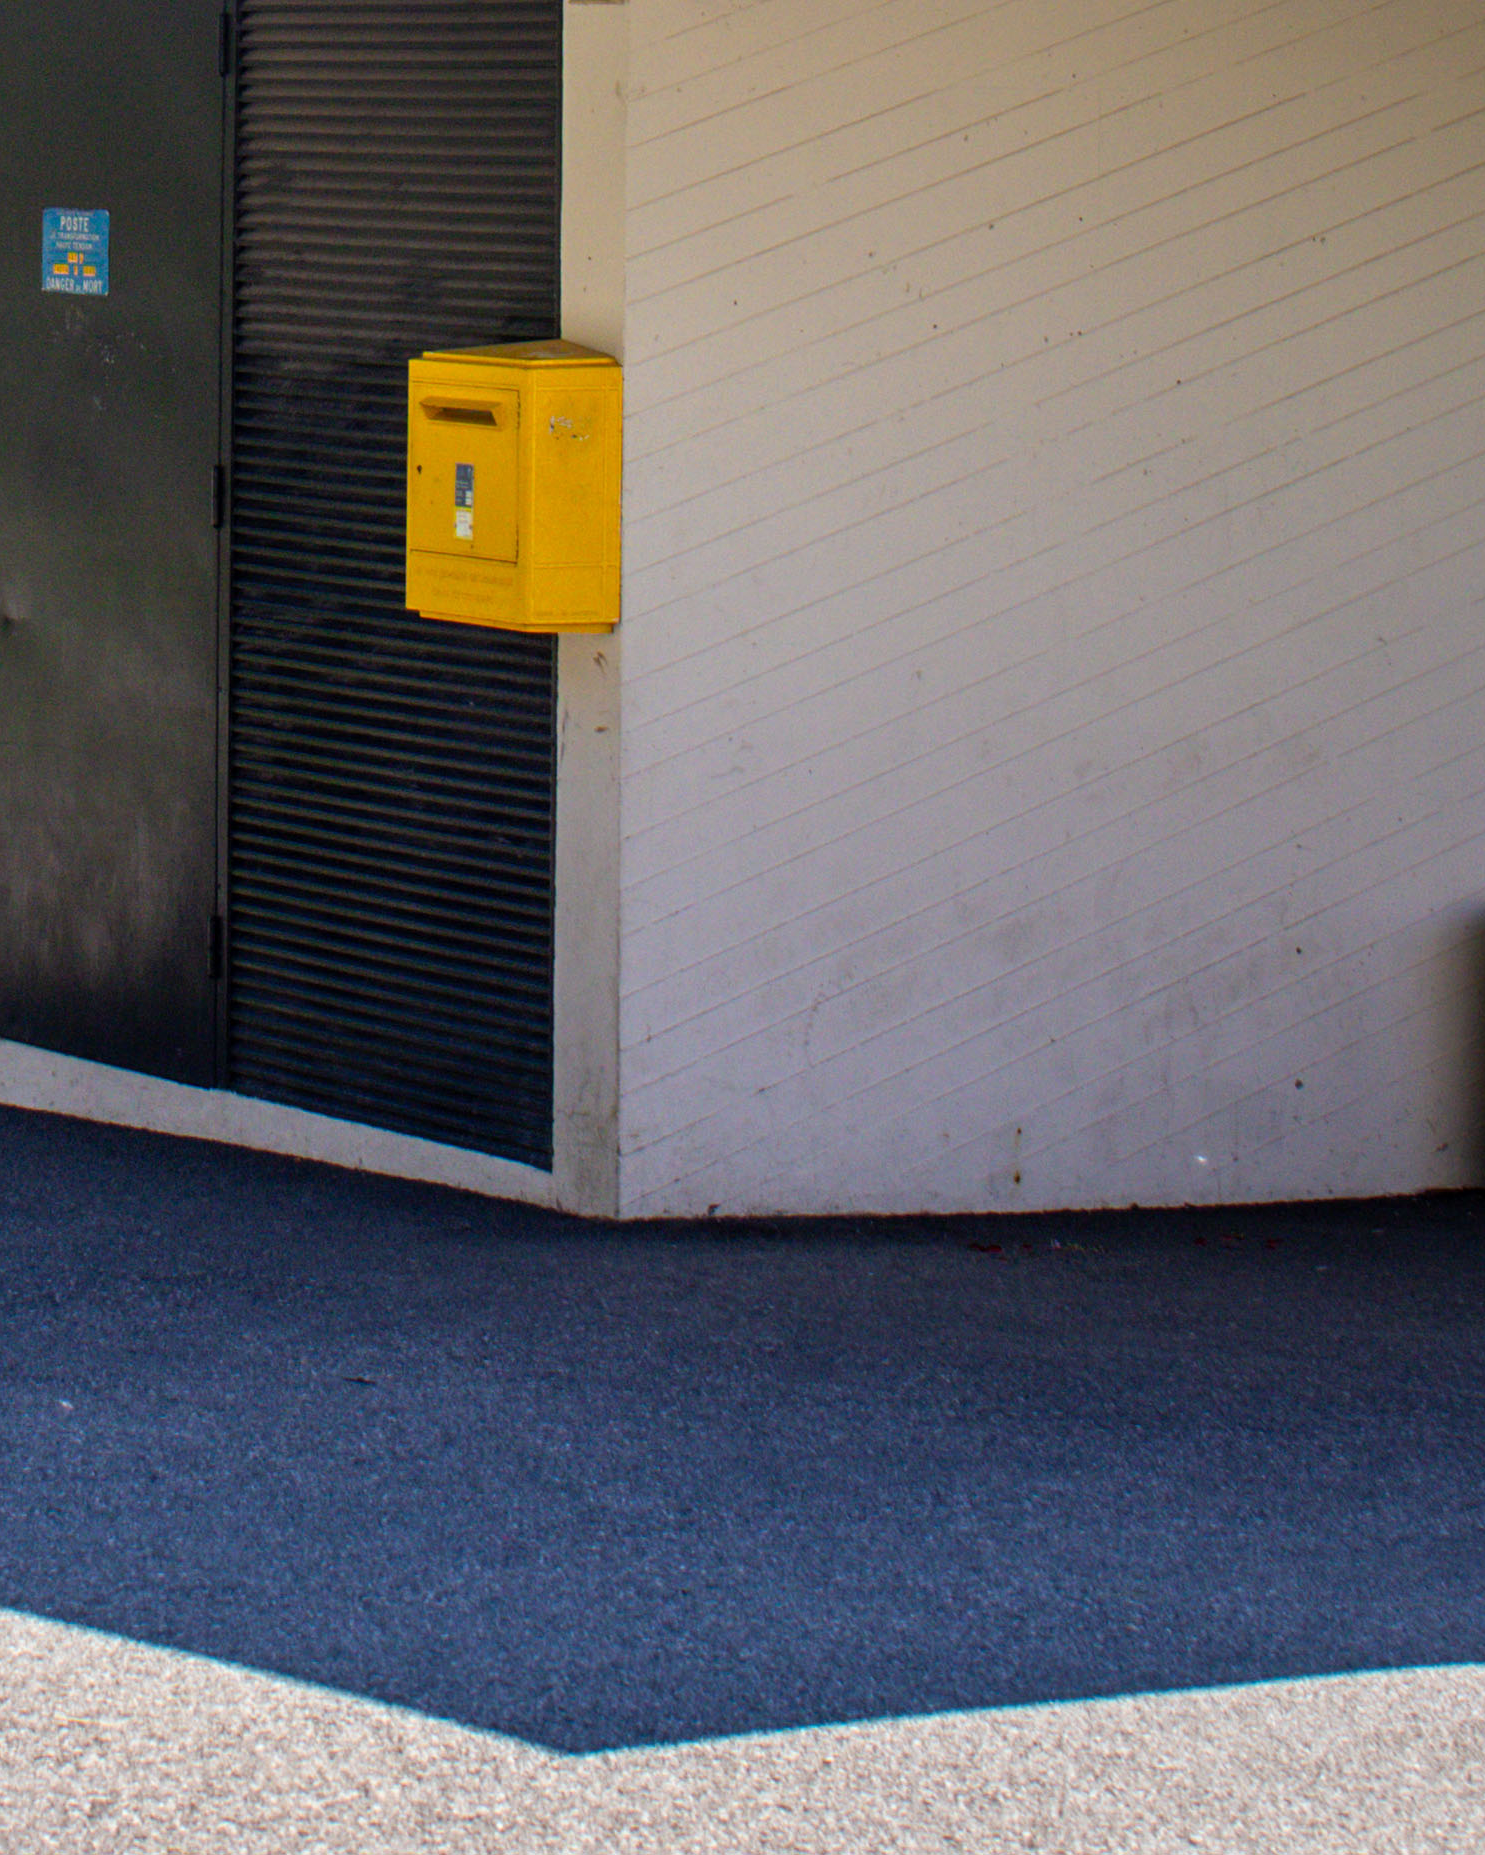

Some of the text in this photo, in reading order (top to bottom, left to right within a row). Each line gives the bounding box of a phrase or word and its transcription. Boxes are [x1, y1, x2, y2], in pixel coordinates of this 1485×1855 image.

[60, 216, 89, 232] POSTE
[46, 277, 75, 292] DANGER
[83, 280, 103, 294] MORT
